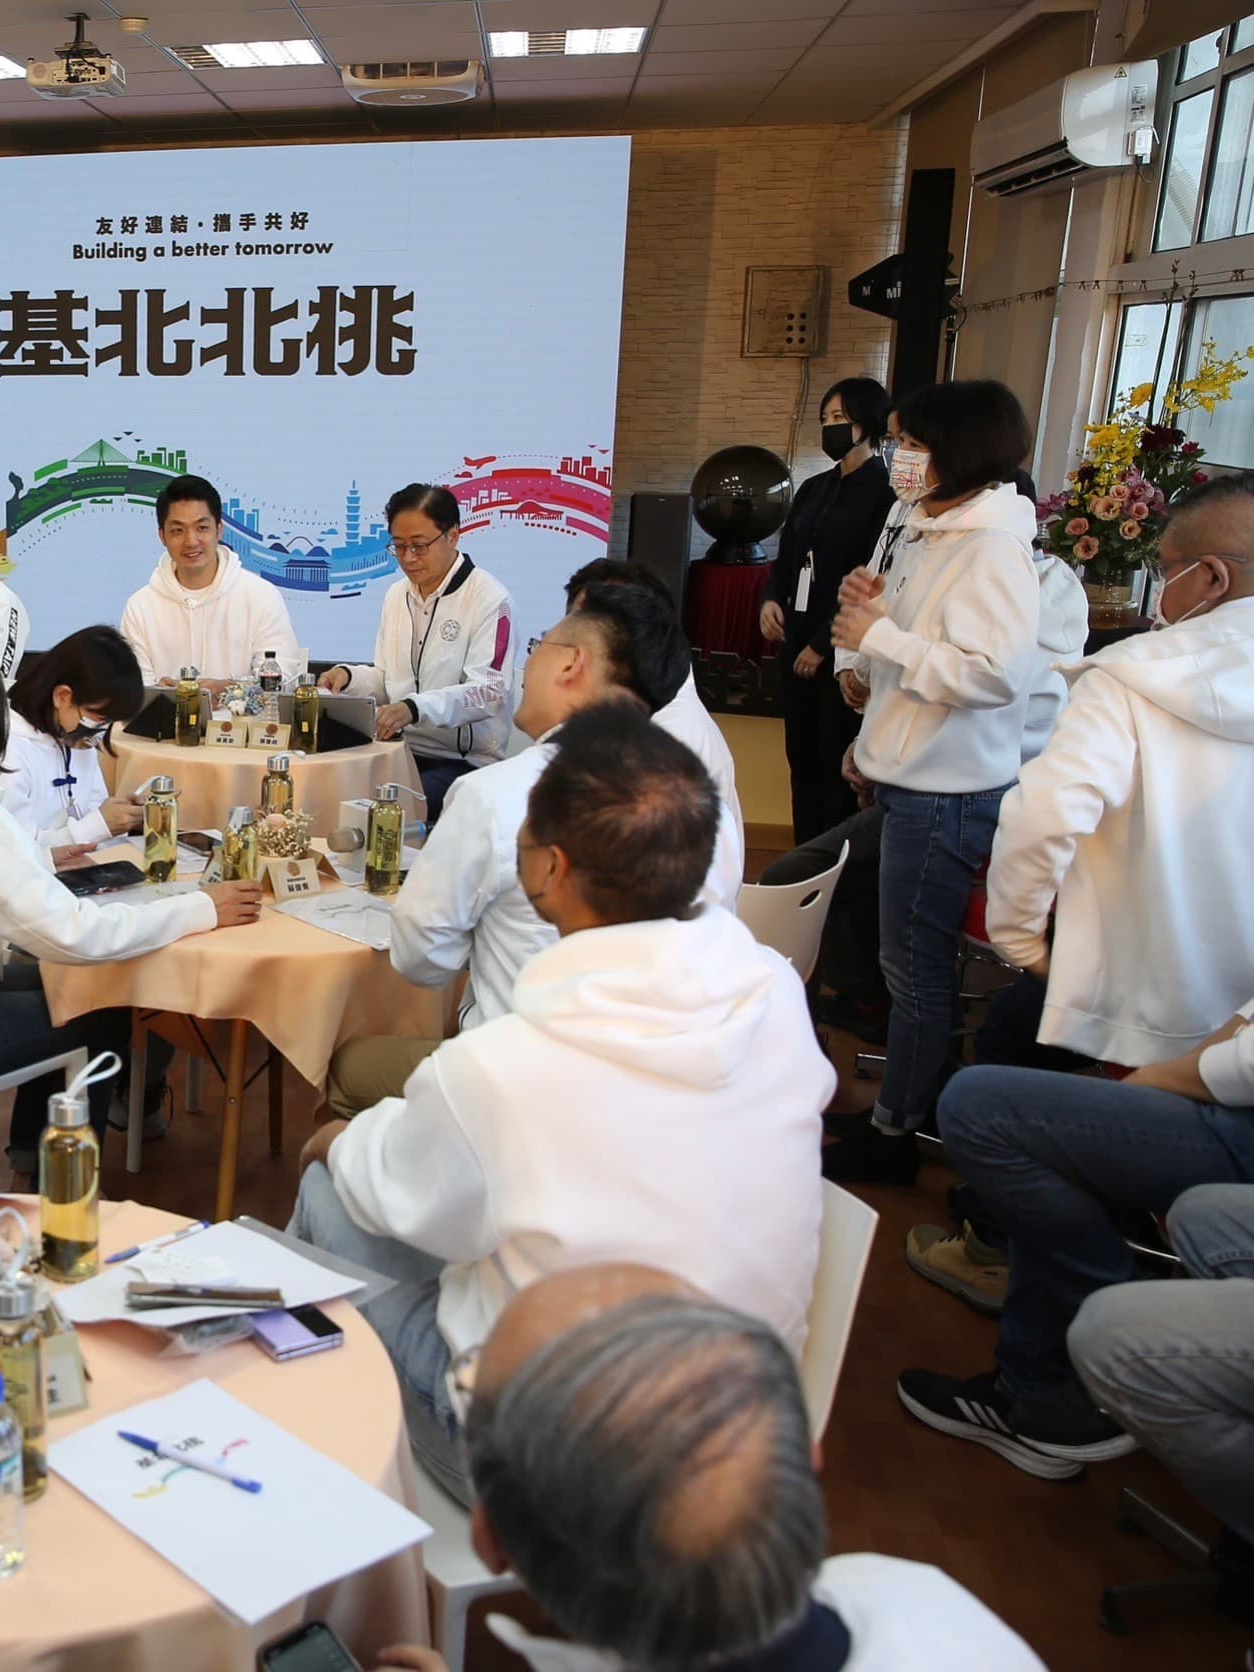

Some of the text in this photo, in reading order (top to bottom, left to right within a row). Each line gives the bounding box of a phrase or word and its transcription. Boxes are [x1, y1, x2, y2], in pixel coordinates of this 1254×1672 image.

[73, 240, 334, 262] Building a better tomorrow
